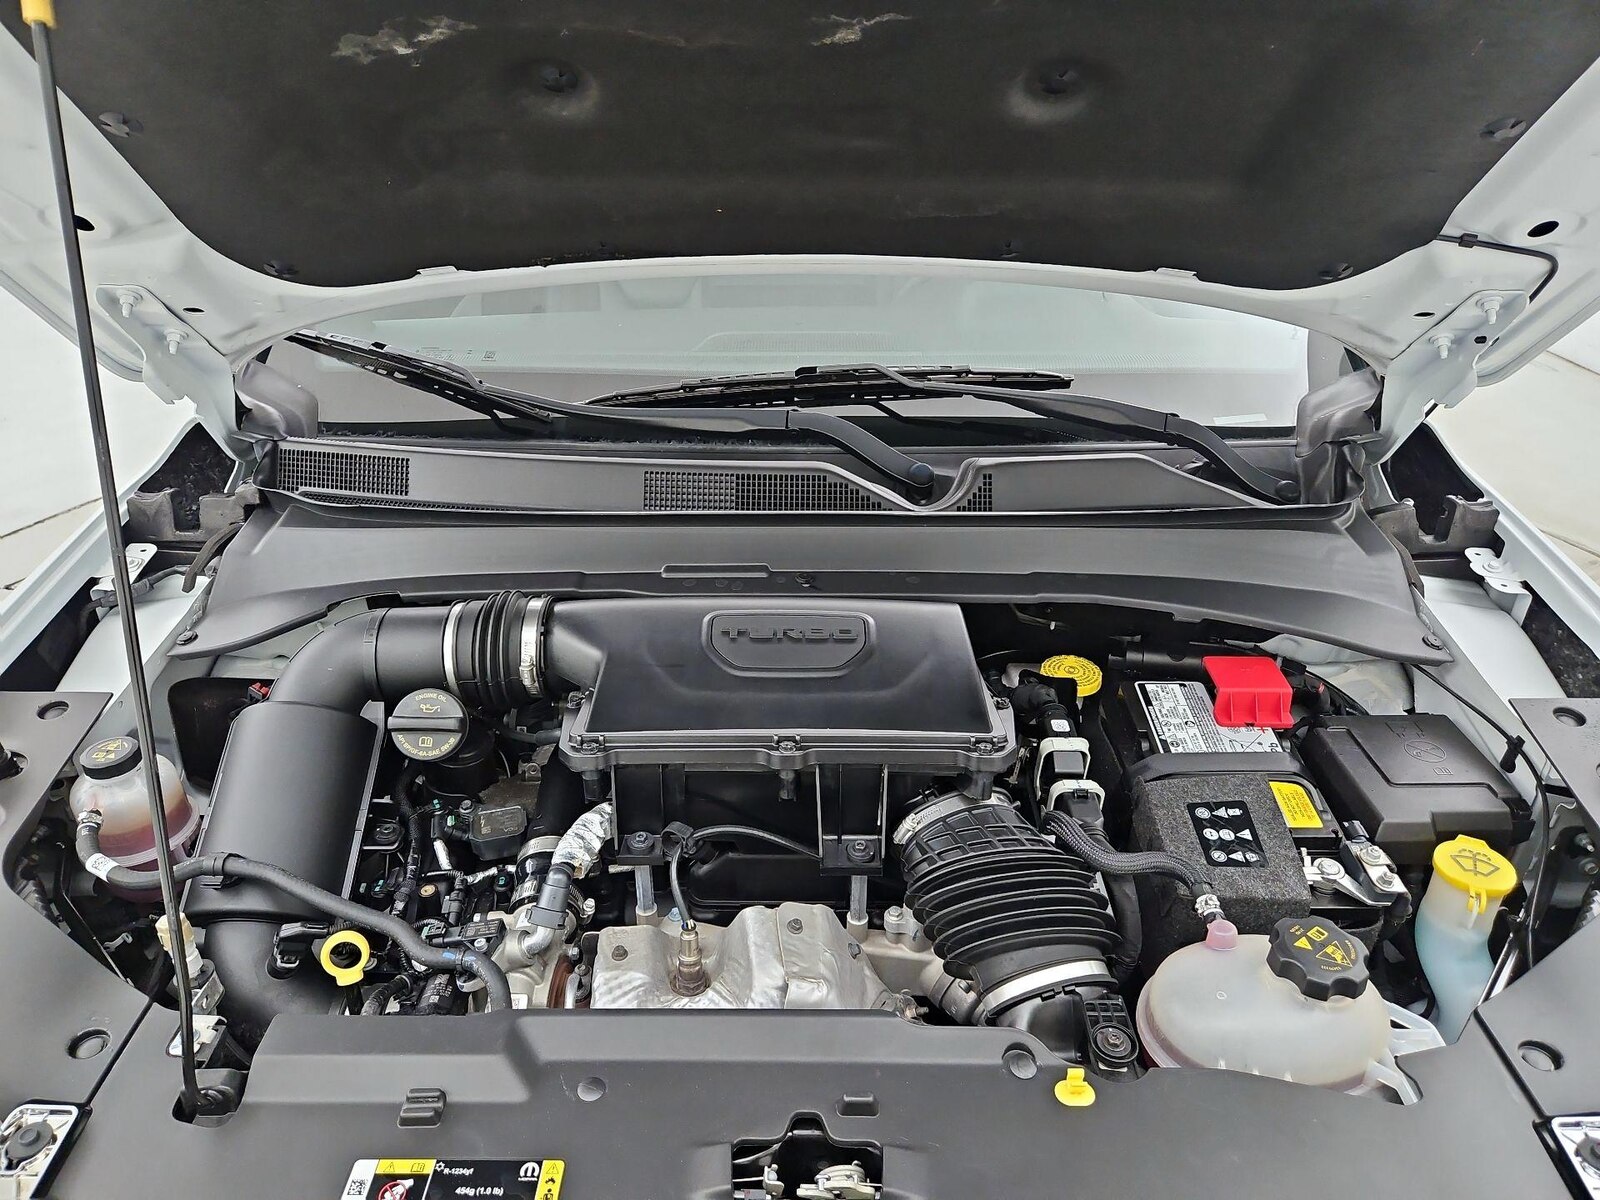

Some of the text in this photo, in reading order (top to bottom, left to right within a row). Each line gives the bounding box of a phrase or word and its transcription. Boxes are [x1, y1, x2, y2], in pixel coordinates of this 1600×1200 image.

[720, 627, 858, 641] TURBO
[415, 692, 447, 703] ENGINE OIL
[455, 1186, 475, 1196] 454g
